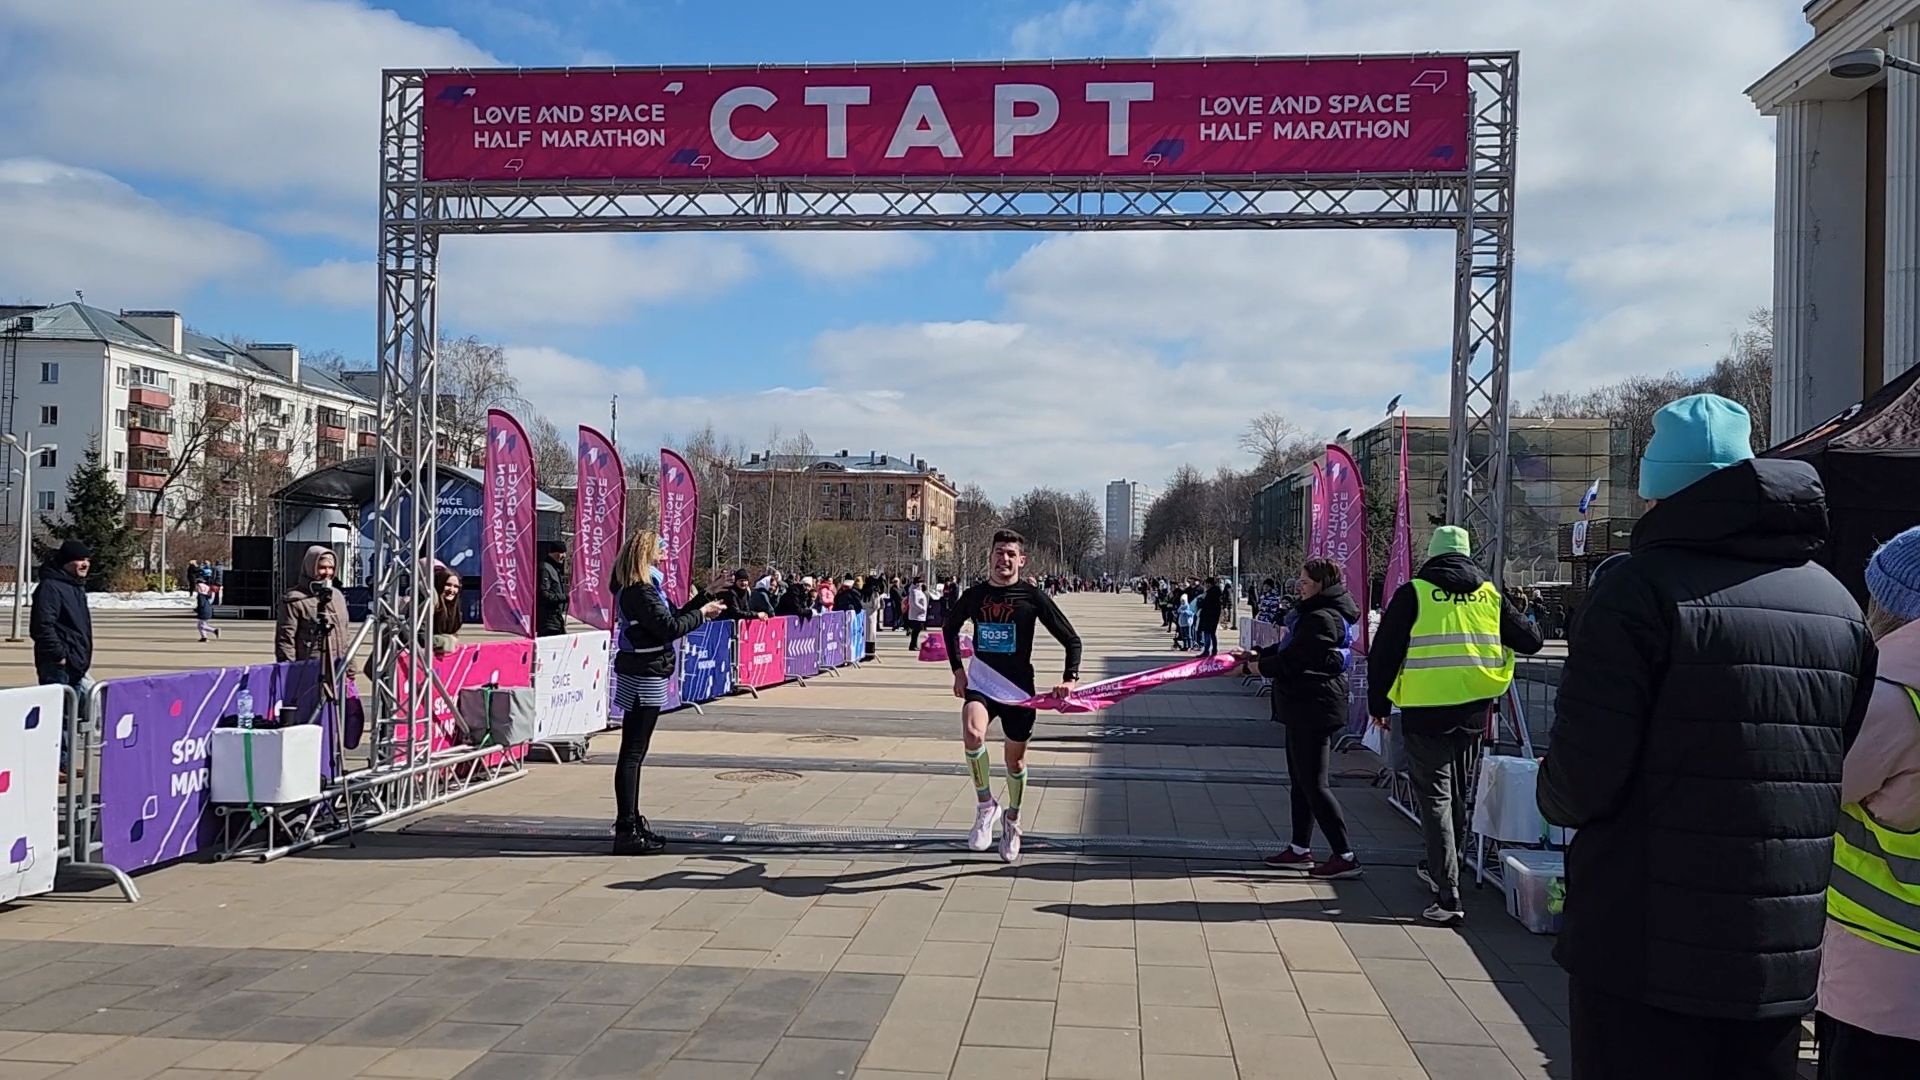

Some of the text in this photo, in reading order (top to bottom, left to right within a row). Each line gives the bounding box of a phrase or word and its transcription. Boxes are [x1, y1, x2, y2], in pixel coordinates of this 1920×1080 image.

[536, 105, 584, 123] AND
[590, 104, 665, 122] SPACE
[1268, 95, 1321, 114] AND
[1328, 94, 1411, 113] SPACE
[709, 81, 1155, 160] СТАРТ
[474, 130, 532, 148] HALF
[1200, 122, 1263, 141] HALF
[435, 497, 463, 506] PACE
[1431, 588, 1488, 605] СУДЬЯ
[981, 630, 1009, 640] 5035
[171, 767, 209, 798] MAR
